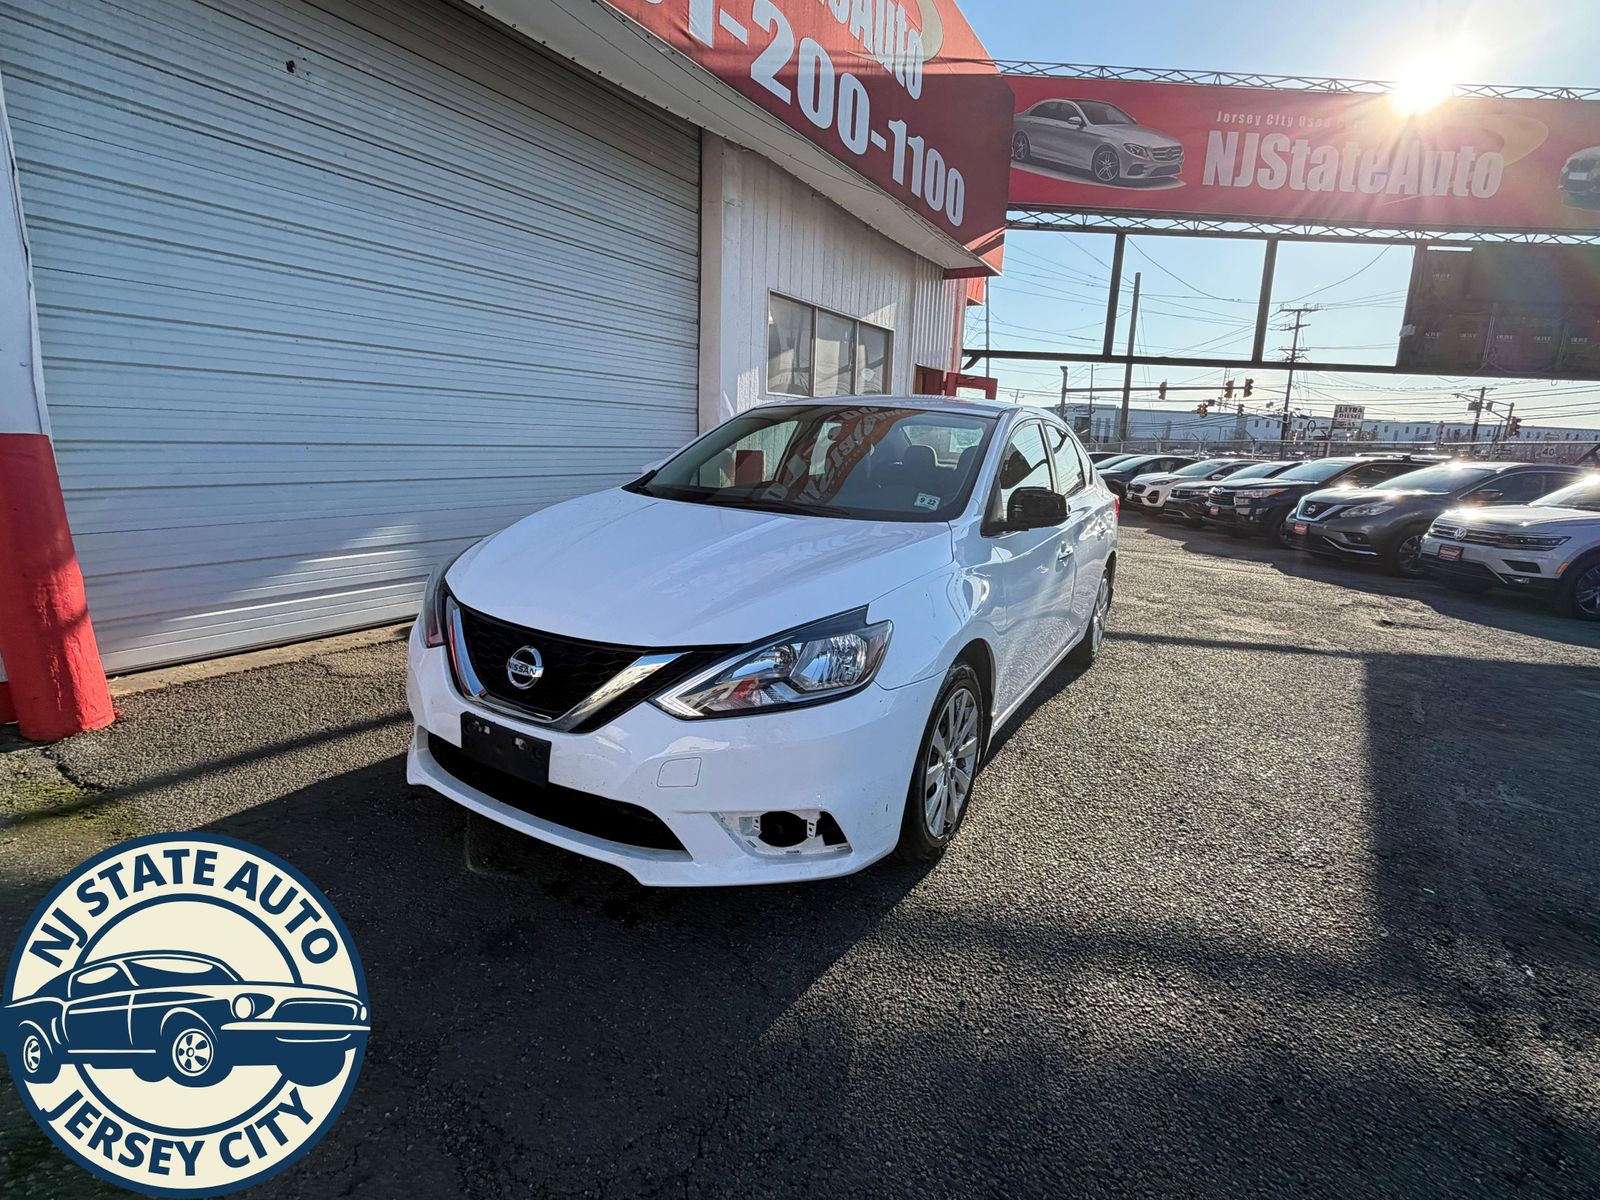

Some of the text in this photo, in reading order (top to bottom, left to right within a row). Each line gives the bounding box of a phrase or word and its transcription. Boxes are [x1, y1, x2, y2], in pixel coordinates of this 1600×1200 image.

[643, 0, 965, 227] -200-1100
[1216, 111, 1261, 126] Jersey
[1203, 130, 1505, 199] NJStateAuto
[508, 661, 537, 675] NISSAN
